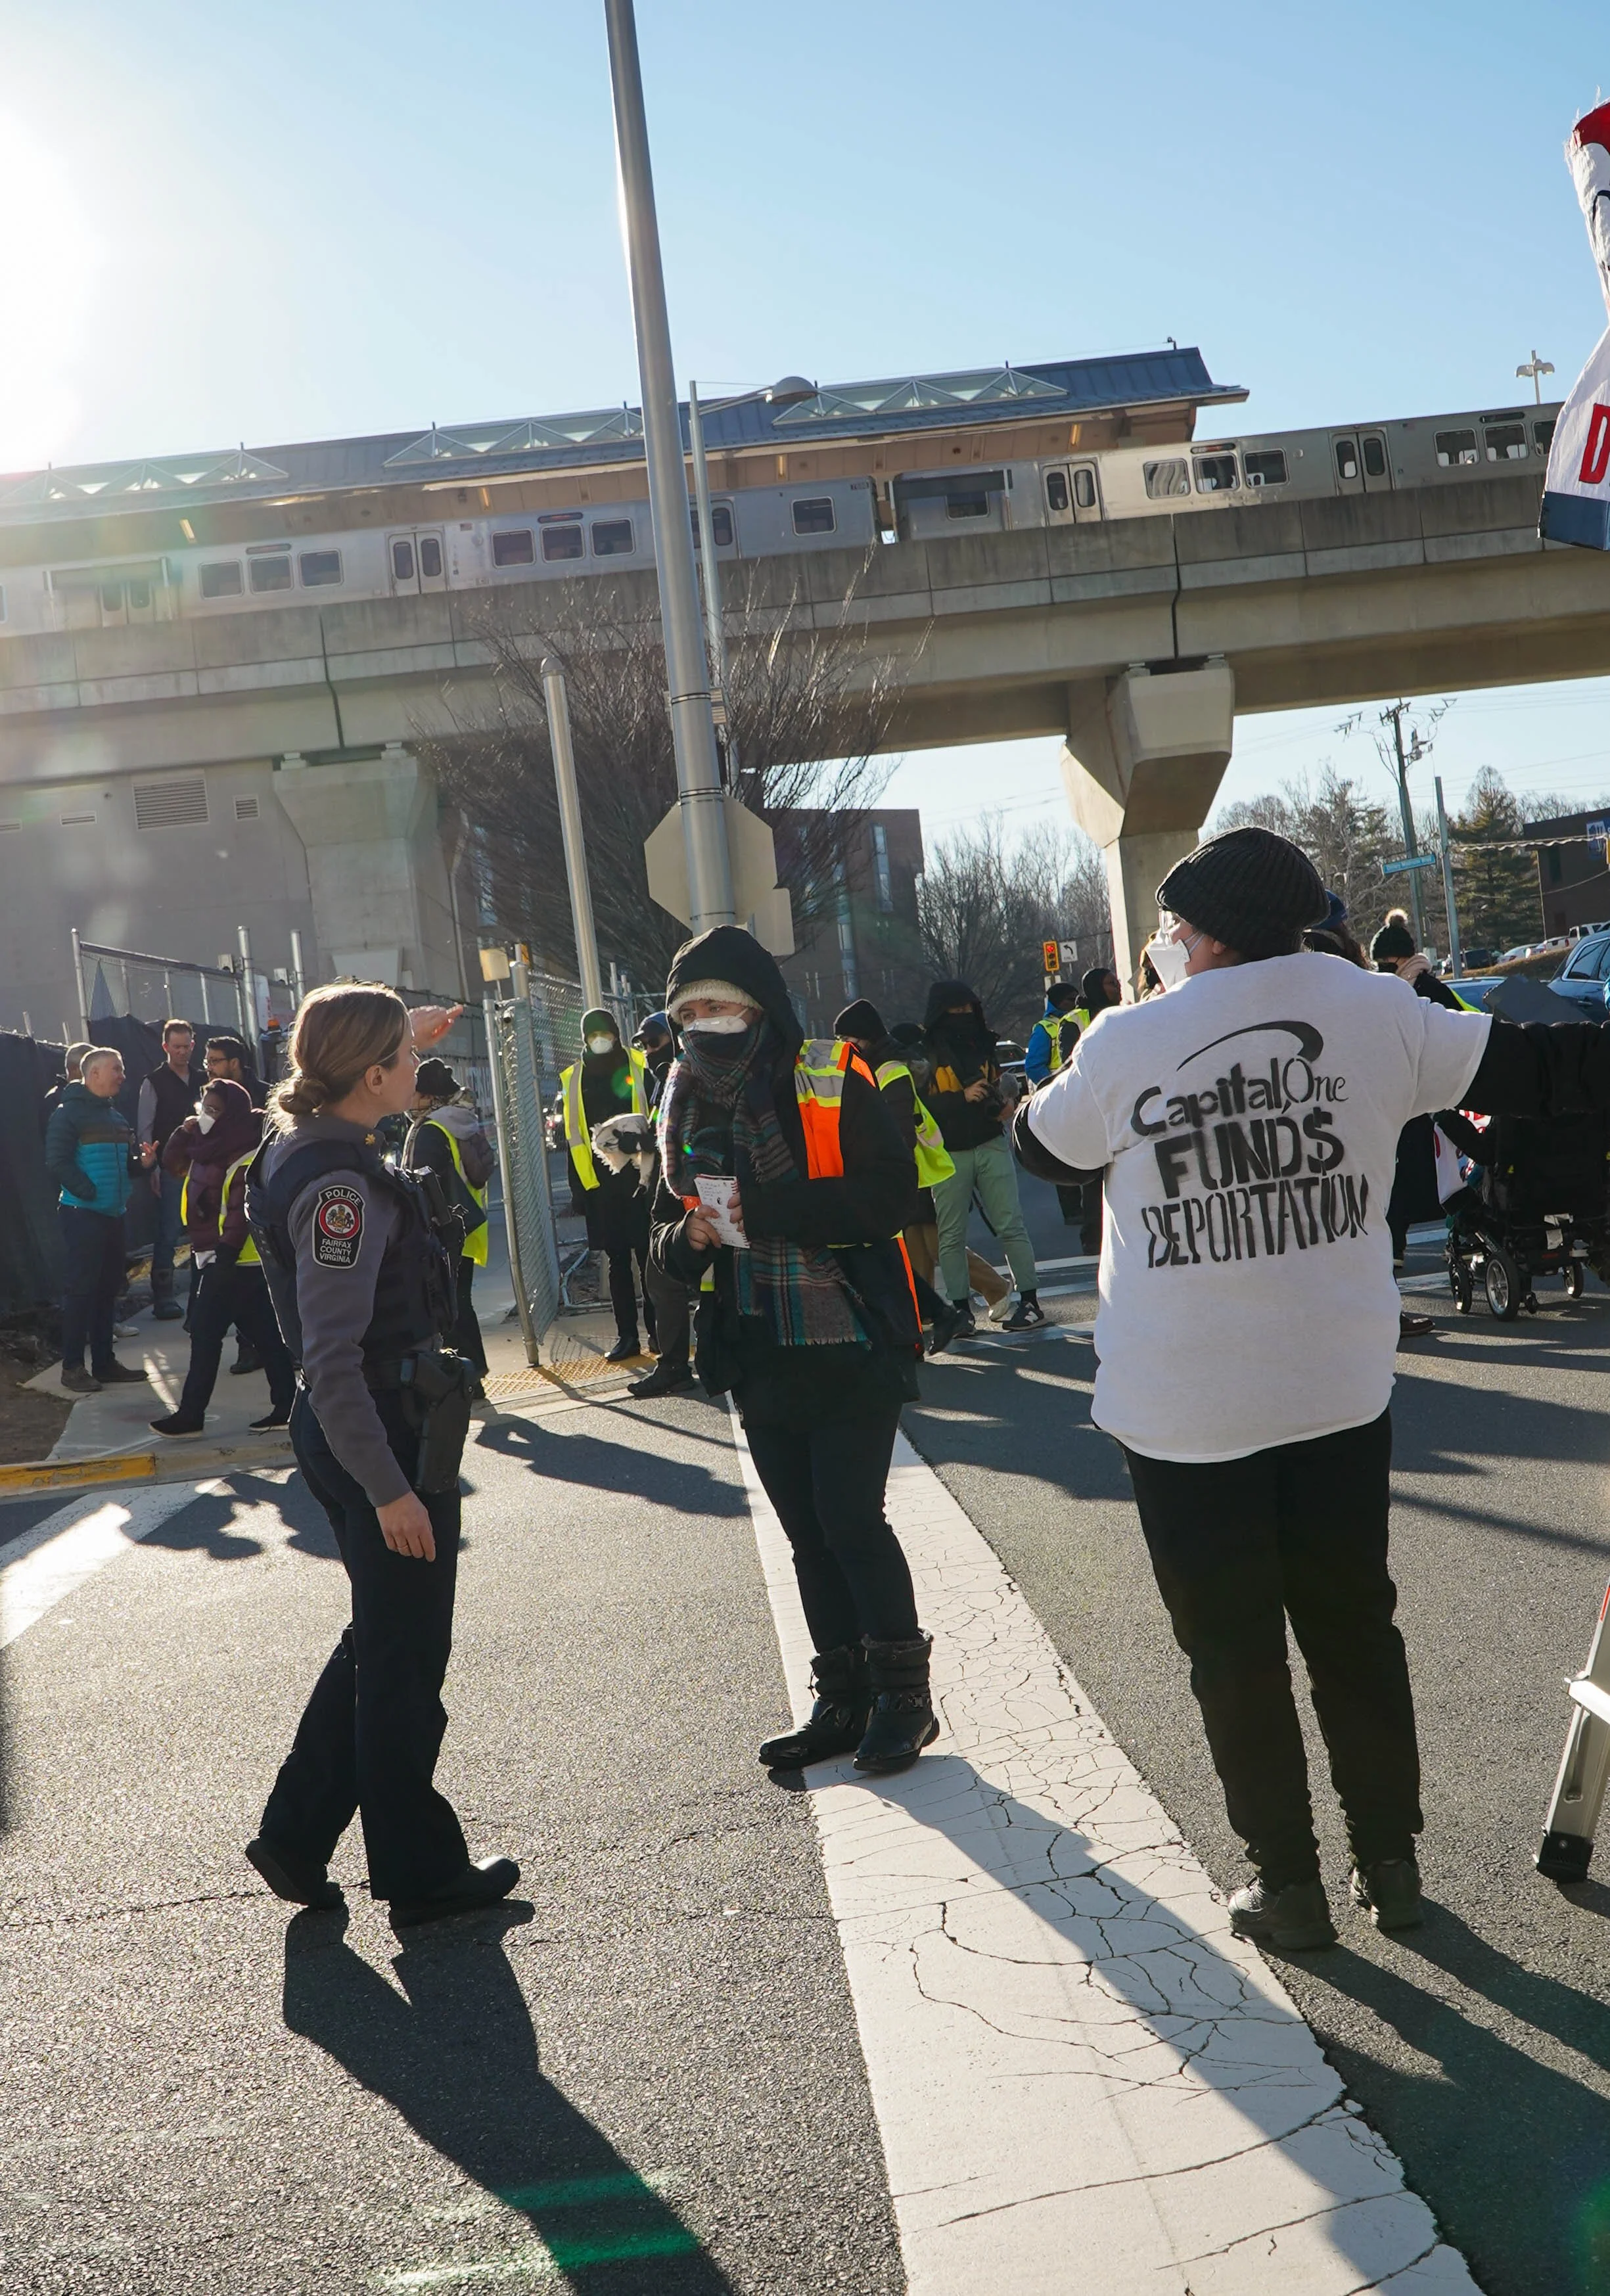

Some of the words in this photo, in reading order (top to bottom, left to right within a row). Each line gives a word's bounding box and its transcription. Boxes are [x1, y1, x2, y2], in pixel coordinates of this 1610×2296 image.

[325, 1189, 361, 1206] POLICE
[1141, 1173, 1369, 1268] DEPORTATION
[322, 1239, 352, 1249] FAIRFAX
[320, 1245, 351, 1256] COUNTY
[319, 1252, 351, 1263] VIRGINIA
